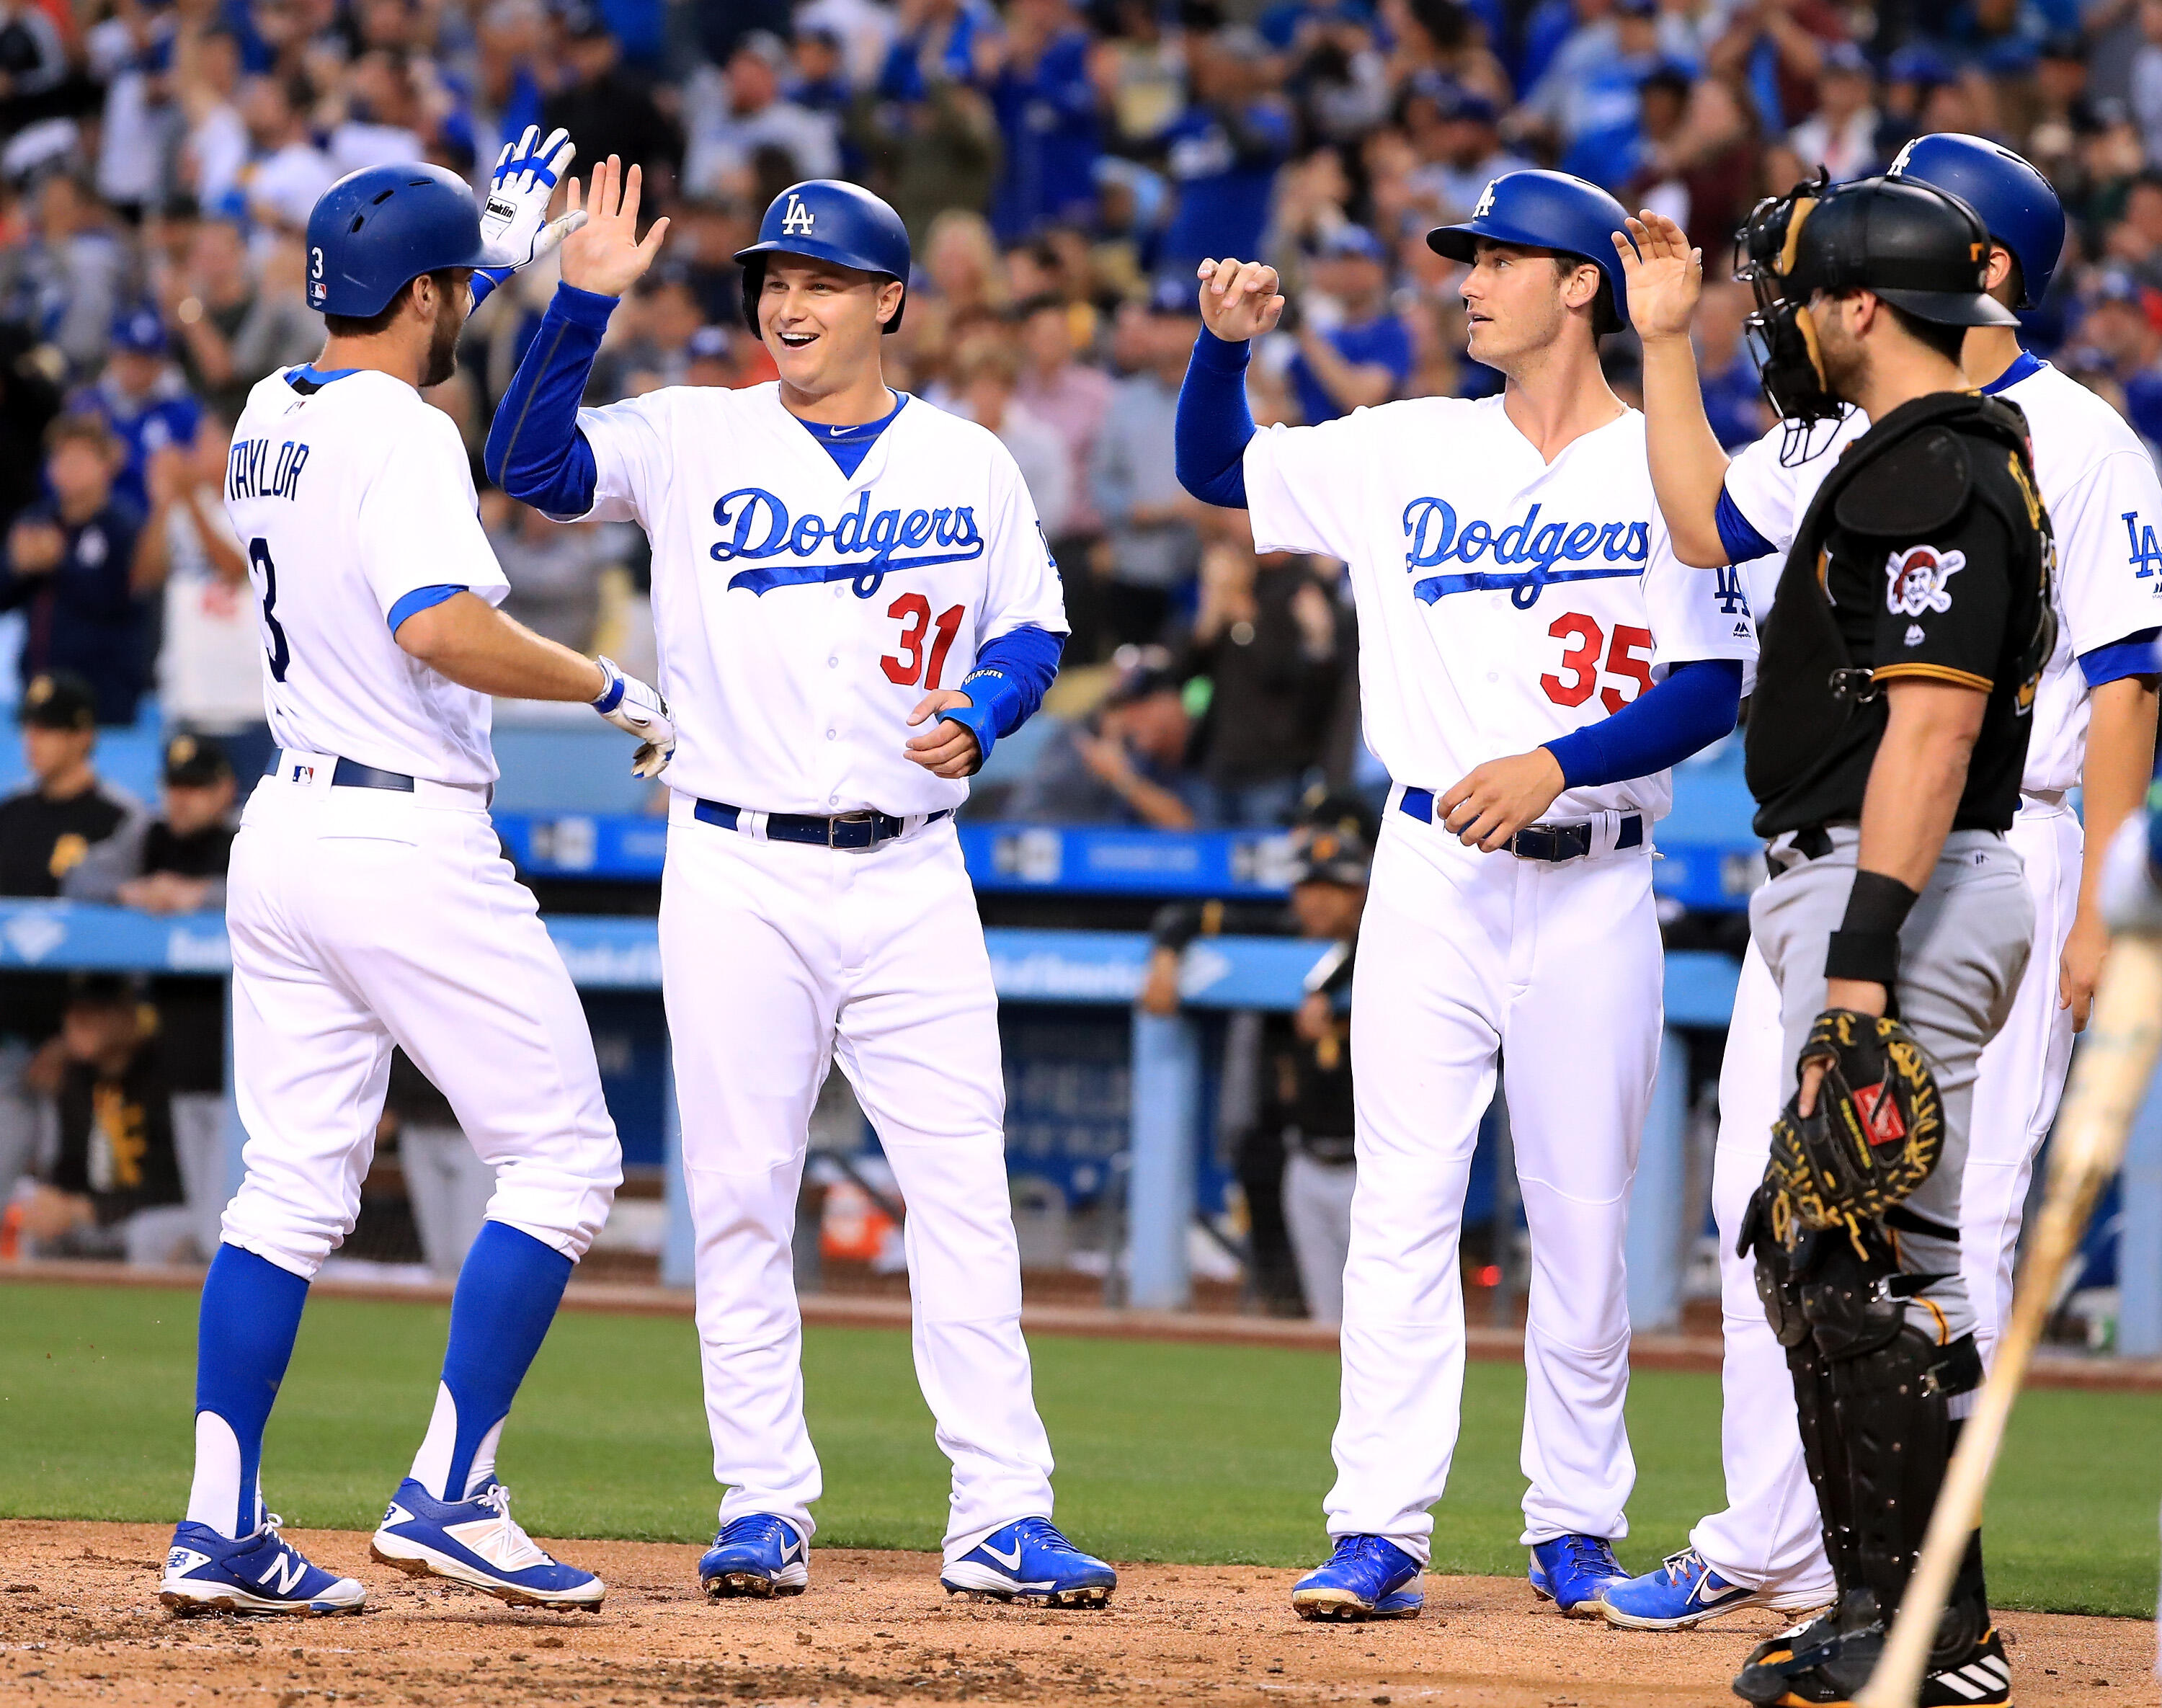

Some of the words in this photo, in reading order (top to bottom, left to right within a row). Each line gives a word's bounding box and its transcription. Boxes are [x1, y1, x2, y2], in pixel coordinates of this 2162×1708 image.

[311, 246, 323, 279] 3
[782, 194, 814, 235] LA
[230, 438, 309, 501] TAYLOR
[710, 487, 984, 599] Dodgers
[1402, 496, 1649, 610] Dodgers
[1714, 566, 1752, 618] LA
[249, 538, 290, 683] 3
[880, 592, 966, 690] 31
[1539, 611, 1655, 716] 35
